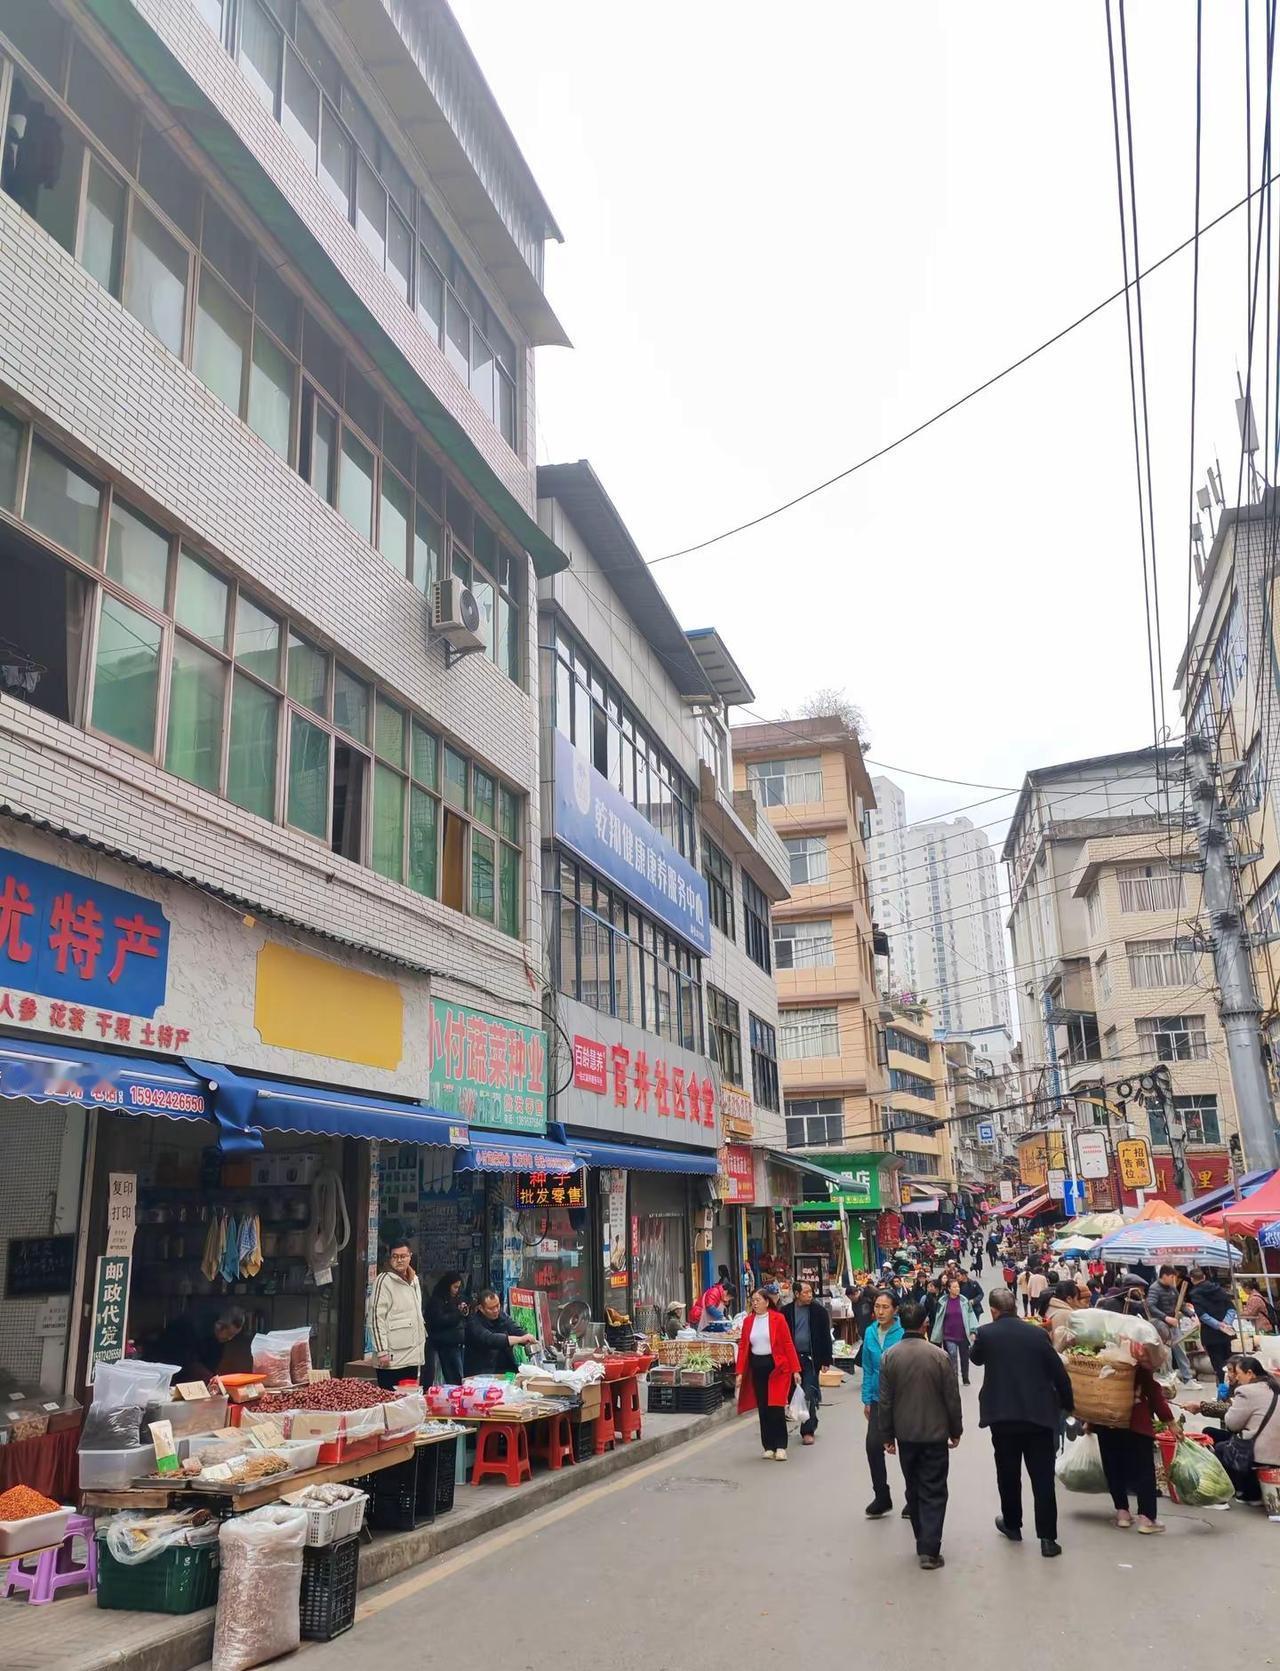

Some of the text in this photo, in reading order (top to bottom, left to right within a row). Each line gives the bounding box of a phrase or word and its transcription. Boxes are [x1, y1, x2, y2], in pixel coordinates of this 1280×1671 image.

[49, 1002, 86, 1033] 花茶
[96, 1013, 132, 1042] 干果
[139, 1023, 191, 1051] 土特产
[611, 1042, 715, 1129] 官井社区食堂
[130, 1085, 206, 1114] 15942426550
[113, 1180, 133, 1197] 复印
[519, 1187, 582, 1204] 批发零售
[111, 1204, 132, 1222] 打印
